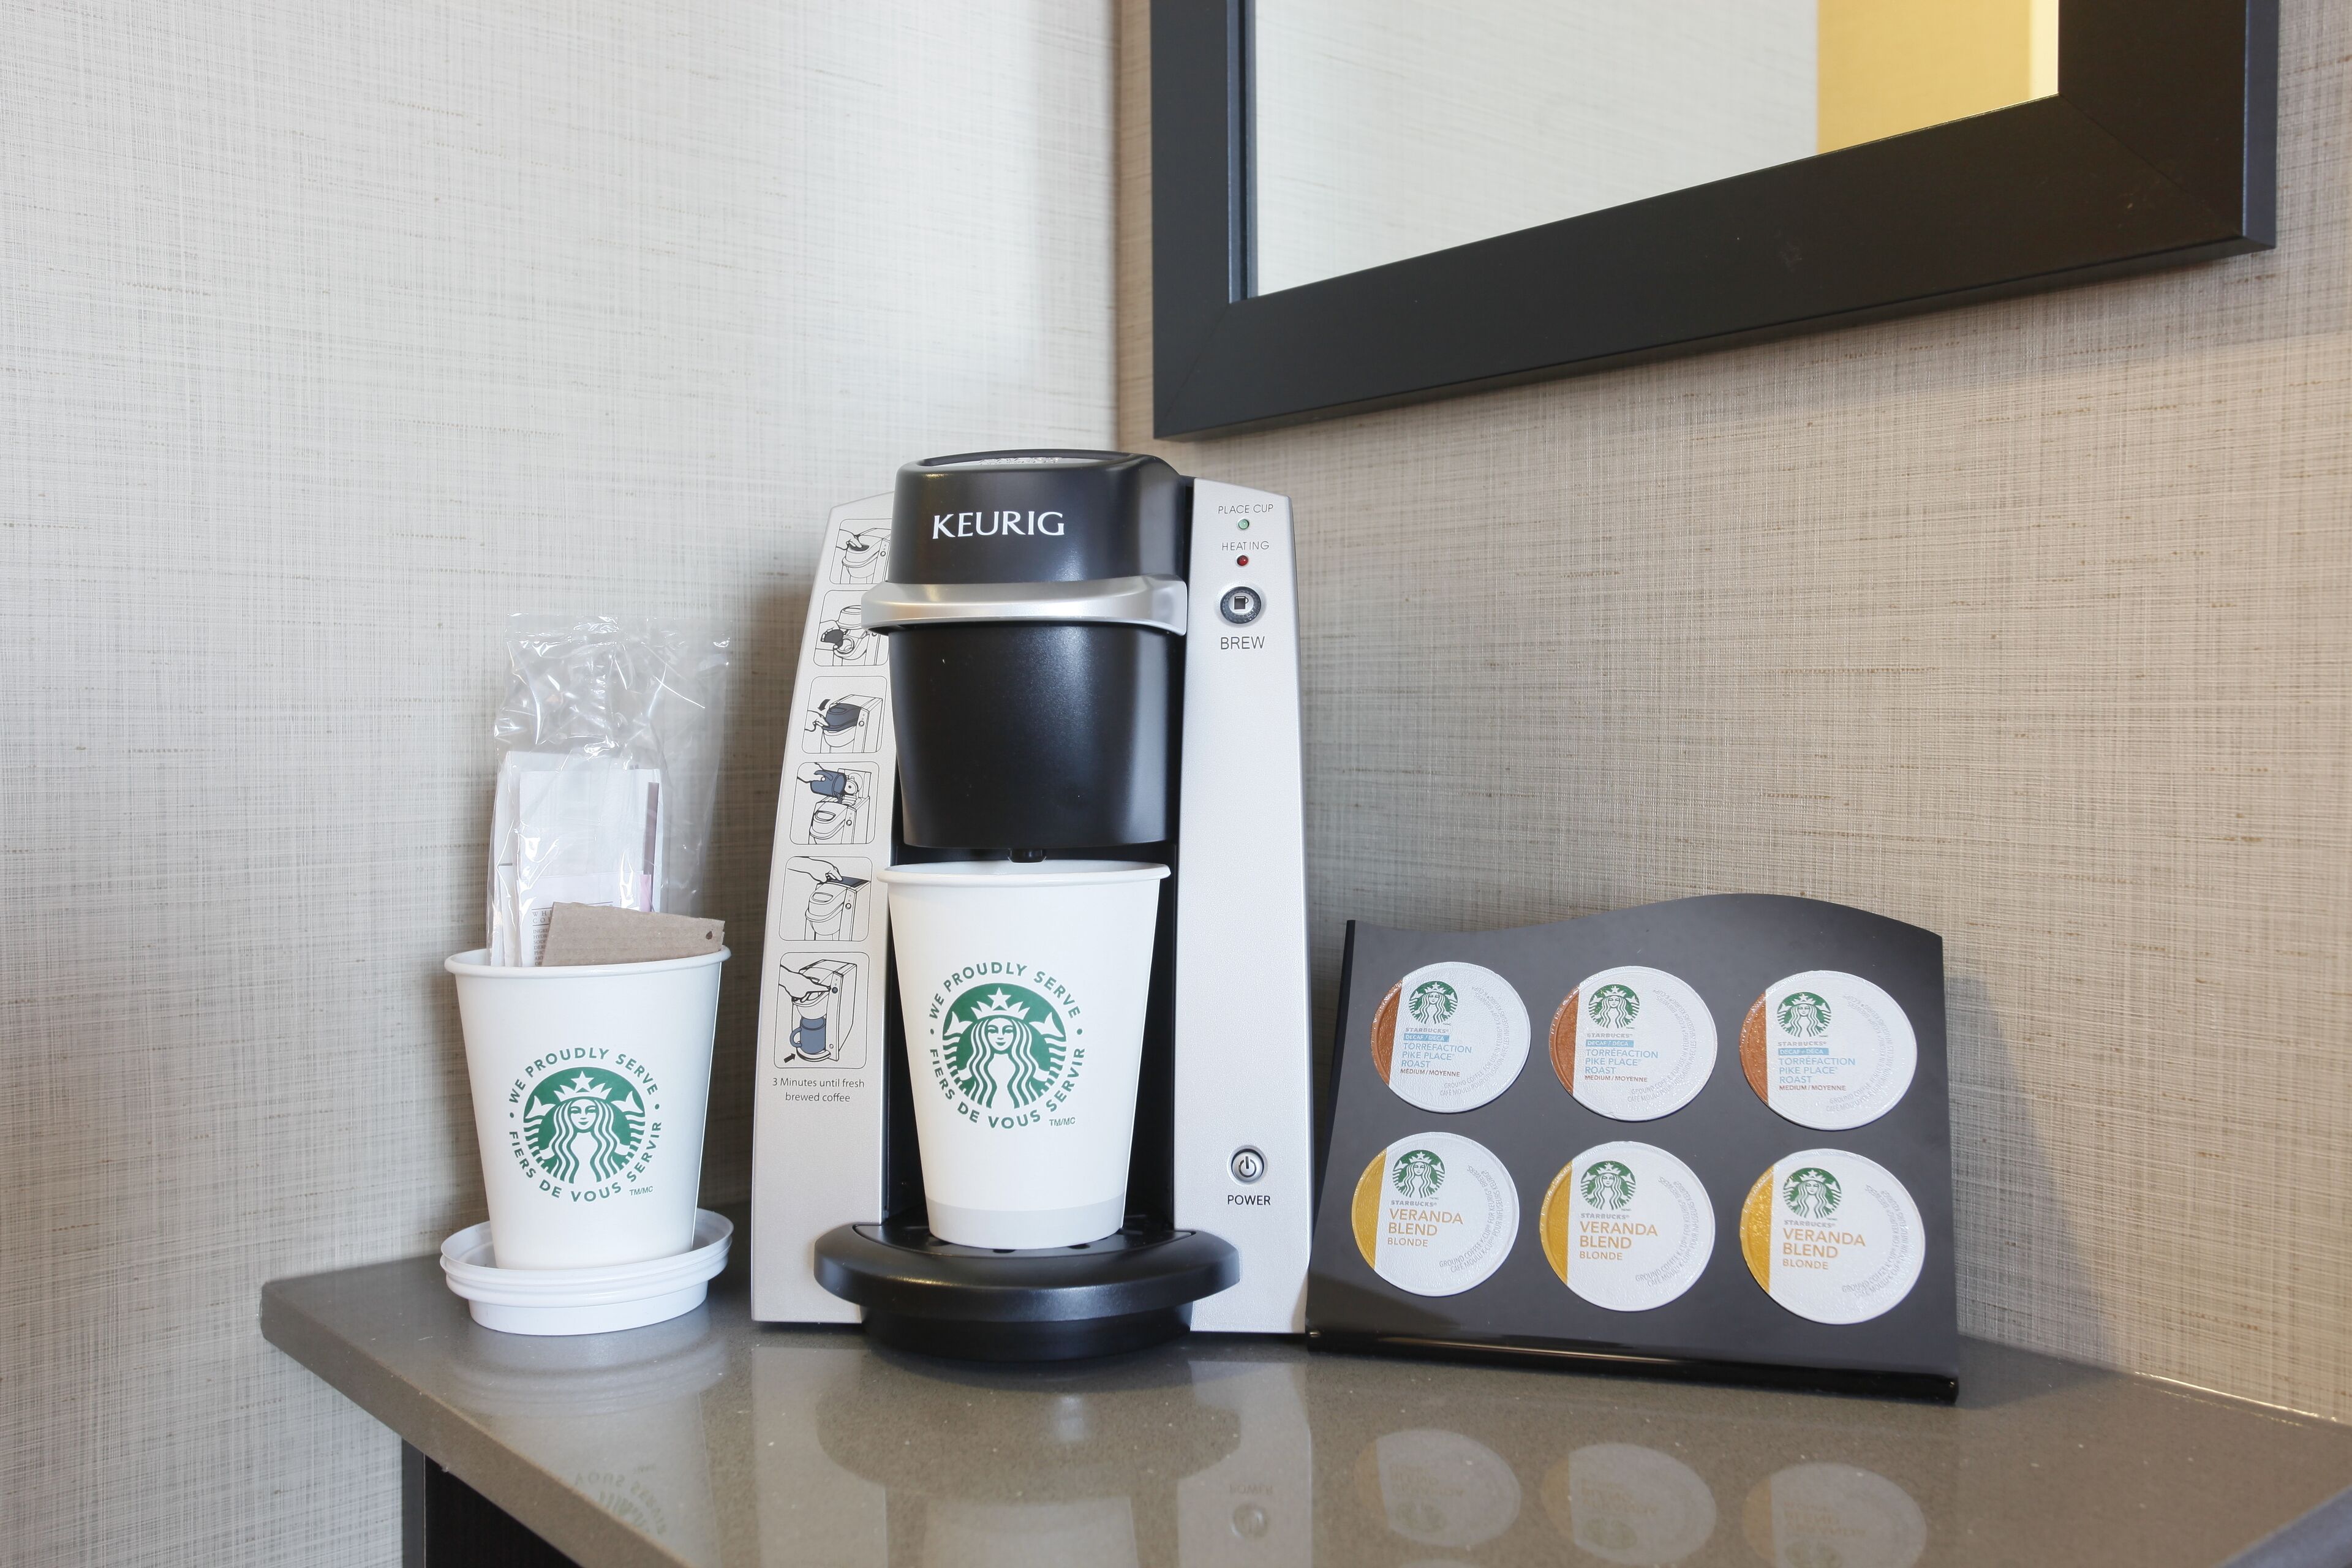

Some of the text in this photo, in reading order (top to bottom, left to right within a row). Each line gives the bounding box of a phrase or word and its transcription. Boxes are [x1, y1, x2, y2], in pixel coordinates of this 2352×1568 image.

[1218, 503, 1274, 514] PLACE CUP
[932, 511, 1065, 539] KEURIG
[1221, 541, 1269, 551] HEATING
[1220, 636, 1265, 650] BREW
[929, 962, 1080, 1019] WE PROUDLY SERVE
[1403, 1042, 1472, 1053] TORRÉFACTION
[1586, 1048, 1659, 1058] TORRÉFACTION
[509, 1047, 658, 1104] WE PROUDLY SERVE
[772, 1077, 864, 1088] 3 Minutes until fresh
[930, 1048, 1085, 1129] FIERS DE VOUS SERVIR
[785, 1092, 850, 1102] brewed coffee
[1049, 1117, 1076, 1126] TM/MC
[509, 1121, 662, 1202] FIERS DE VOUS SERVIR
[629, 1186, 654, 1196] TM/MC
[1227, 1195, 1271, 1205] POWER
[1389, 1208, 1463, 1225] VERANDA
[1389, 1222, 1438, 1236] BLEND
[1580, 1221, 1658, 1237] VERANDA
[1387, 1237, 1428, 1247] BLONDE
[1580, 1235, 1632, 1250] BLEND
[1783, 1227, 1866, 1246] VERANDA
[1579, 1251, 1623, 1261] BLONDE
[1783, 1242, 1838, 1258] BLEND
[1783, 1258, 1828, 1270] BLONDE
